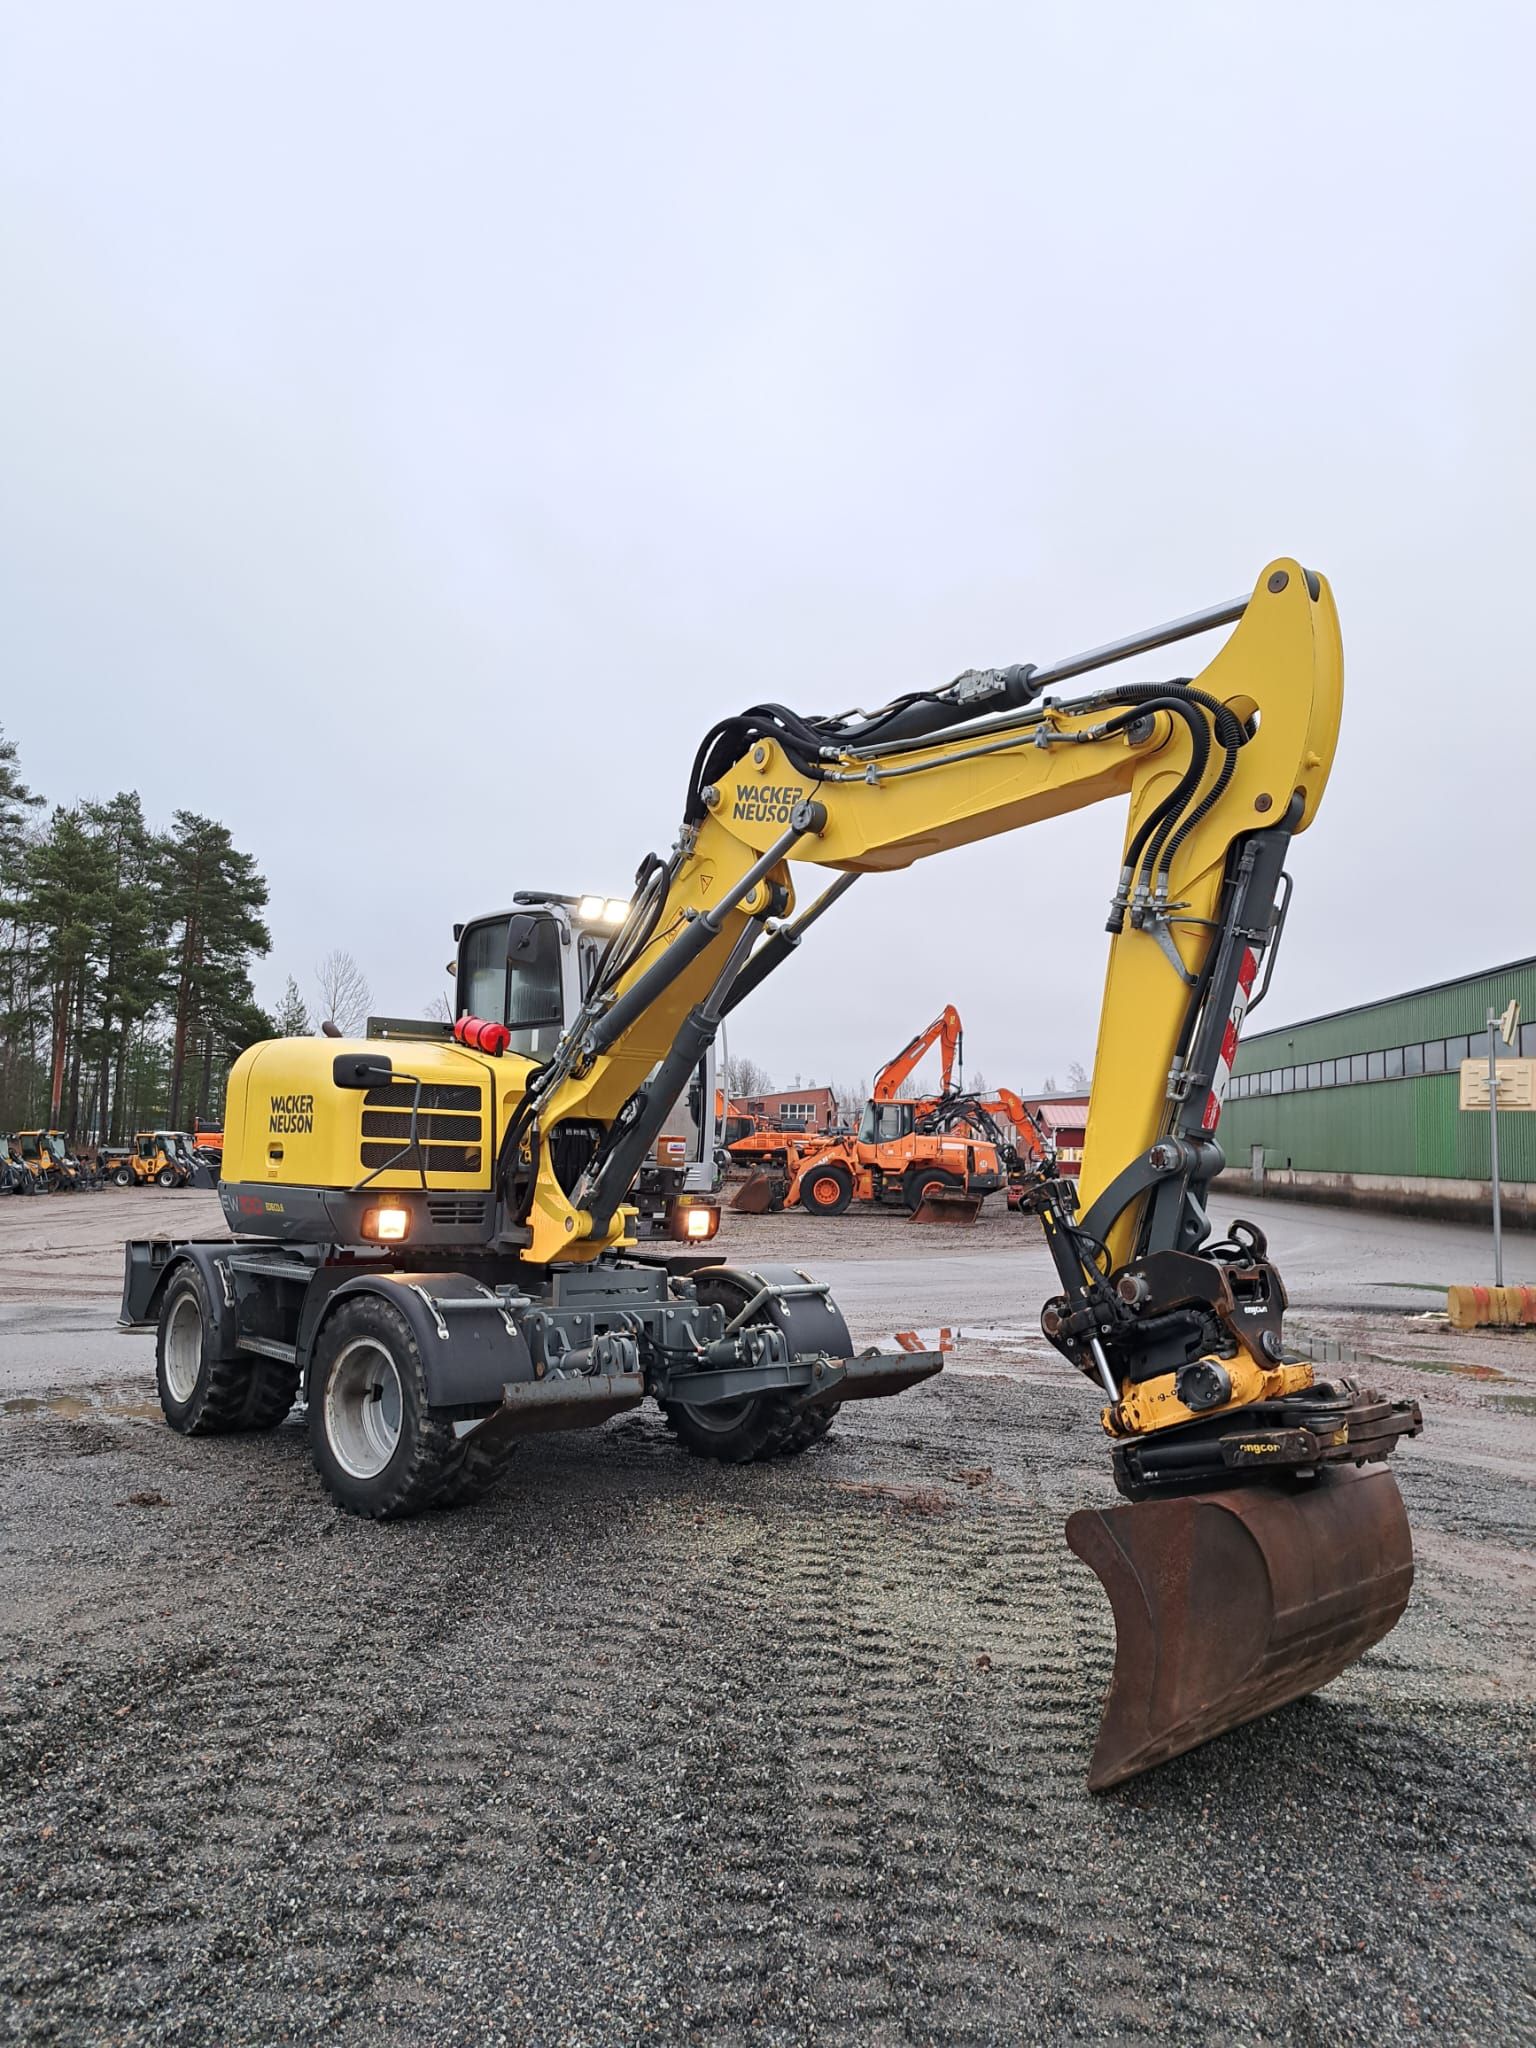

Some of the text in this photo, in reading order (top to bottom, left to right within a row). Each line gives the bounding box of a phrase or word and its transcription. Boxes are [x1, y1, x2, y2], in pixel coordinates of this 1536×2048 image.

[736, 784, 803, 805] WACKER
[270, 1094, 314, 1114] WACKER
[269, 1114, 313, 1134] NEUSON
